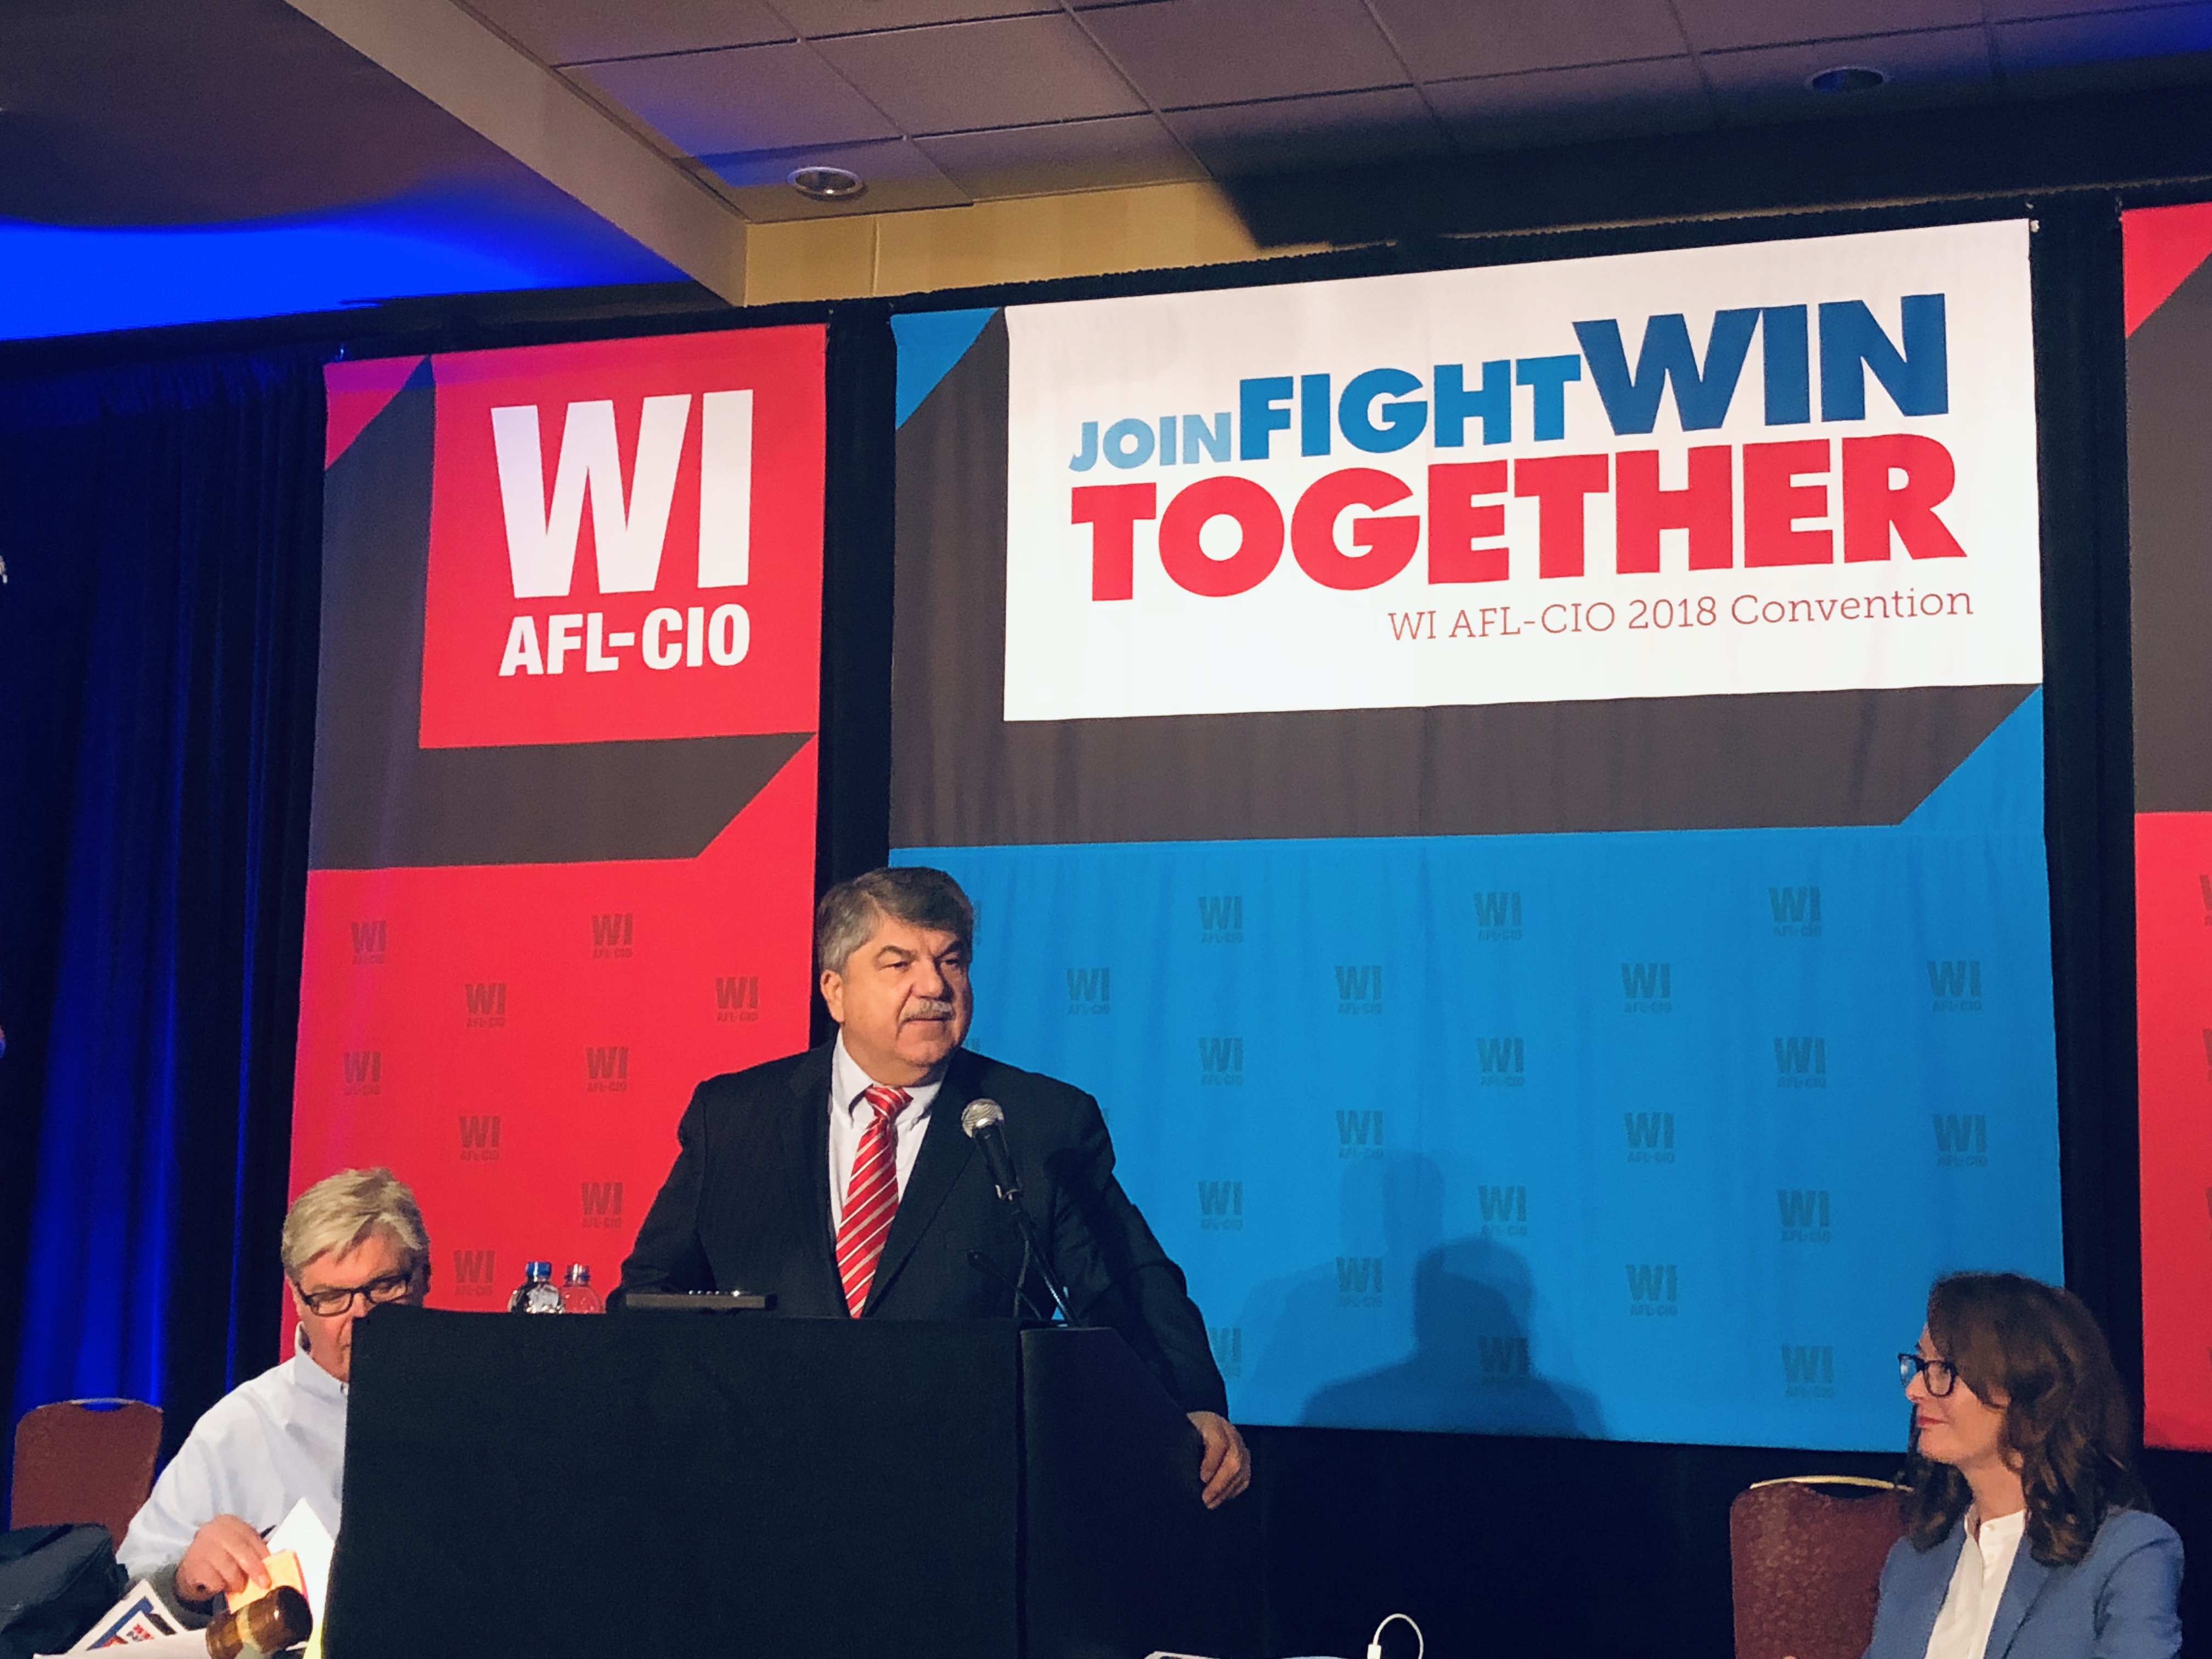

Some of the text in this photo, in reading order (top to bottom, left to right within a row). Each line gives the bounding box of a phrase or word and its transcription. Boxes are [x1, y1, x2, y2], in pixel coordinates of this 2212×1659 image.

[491, 389, 753, 599] WI
[1070, 433, 1968, 602] TOGETHER
[1387, 590, 1973, 641] WI AFL-CIO 2018 Convention
[499, 603, 751, 676] AFL-CIO
[1199, 896, 1243, 930] WI
[1474, 891, 1522, 927] WI
[1769, 885, 1821, 923] WI
[351, 921, 387, 953] WI
[592, 914, 633, 945] WI
[716, 977, 758, 1010] WI
[1066, 967, 1110, 1001] WI
[1335, 966, 1382, 1000] WI
[1621, 963, 1671, 998] WI
[1927, 960, 1981, 997] WI
[465, 983, 506, 1015] WI
[345, 1051, 381, 1082] WI
[587, 1047, 629, 1079] WI
[1199, 1037, 1243, 1071] WI
[1477, 1037, 1523, 1073] WI
[1774, 1037, 1826, 1074] WI
[459, 1116, 500, 1148] WI
[1336, 1109, 1383, 1145] WI
[1624, 1112, 1674, 1148] WI
[1933, 1114, 1987, 1152] WI
[582, 1182, 623, 1214] WI
[1199, 1181, 1243, 1215] WI
[1479, 1186, 1527, 1221] WI
[1778, 1190, 1830, 1227] WI
[454, 1250, 494, 1282] WI
[1336, 1257, 1383, 1293] WI
[1626, 1265, 1678, 1301] WI
[1781, 1344, 1833, 1383] WI
